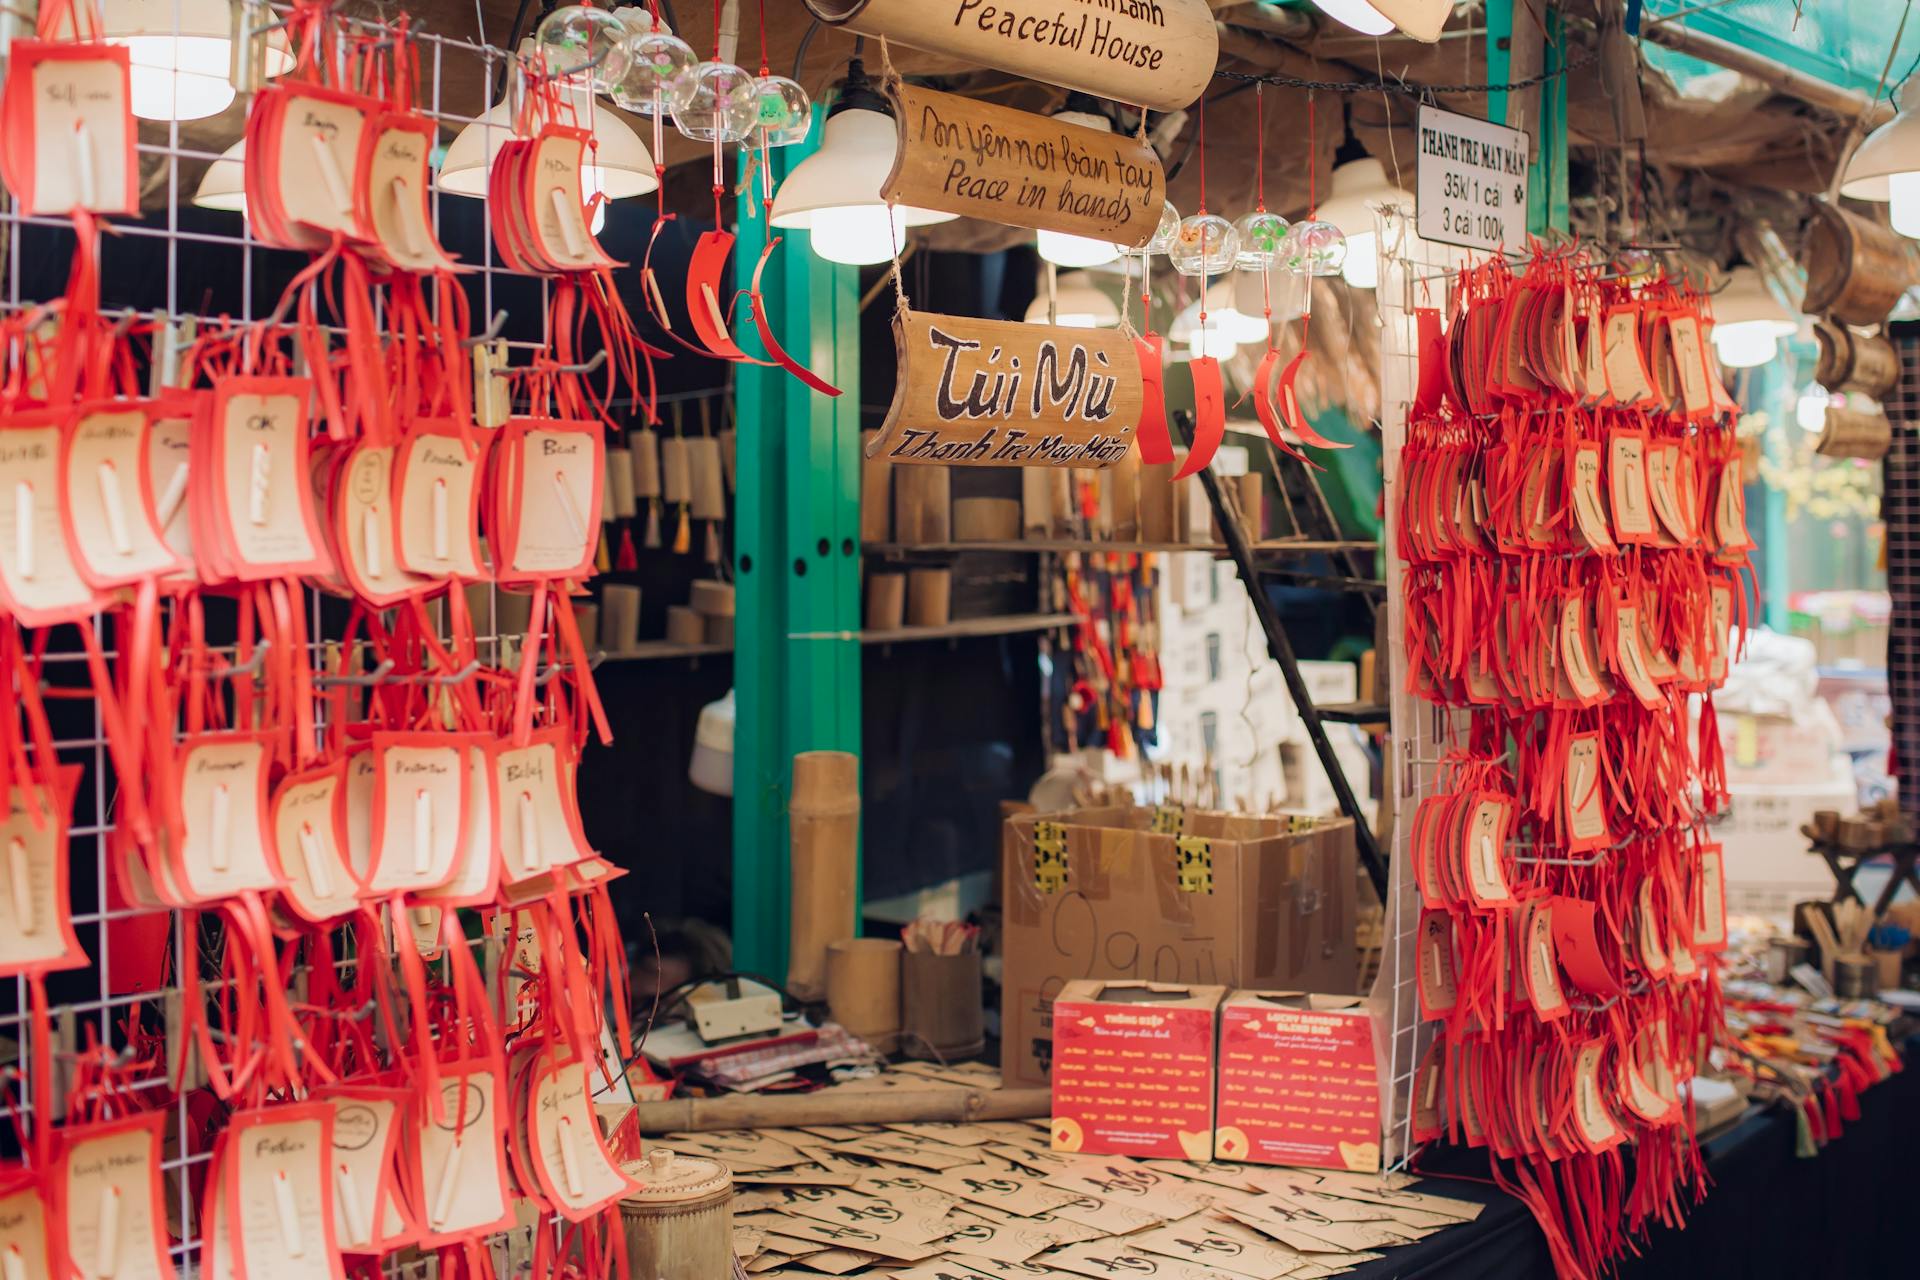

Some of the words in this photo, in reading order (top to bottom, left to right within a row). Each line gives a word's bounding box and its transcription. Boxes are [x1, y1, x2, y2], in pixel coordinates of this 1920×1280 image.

[954, 0, 1088, 52] Peaceful
[1090, 17, 1164, 71] House
[966, 120, 1012, 167] yên
[1061, 135, 1110, 184] bàn
[1421, 127, 1459, 161] THANH
[1460, 136, 1479, 165] TRE
[1481, 143, 1502, 171] MAY
[1017, 176, 1047, 211] in
[1474, 180, 1479, 204] 1
[1484, 182, 1503, 208] cái
[1443, 207, 1451, 232] 3
[1454, 210, 1473, 236] cái
[928, 325, 1023, 421] Túi
[1031, 339, 1118, 422] Mù
[246, 415, 278, 431] OK
[889, 426, 998, 460] Thanh
[991, 428, 1028, 462] Tre
[1028, 434, 1079, 464] May
